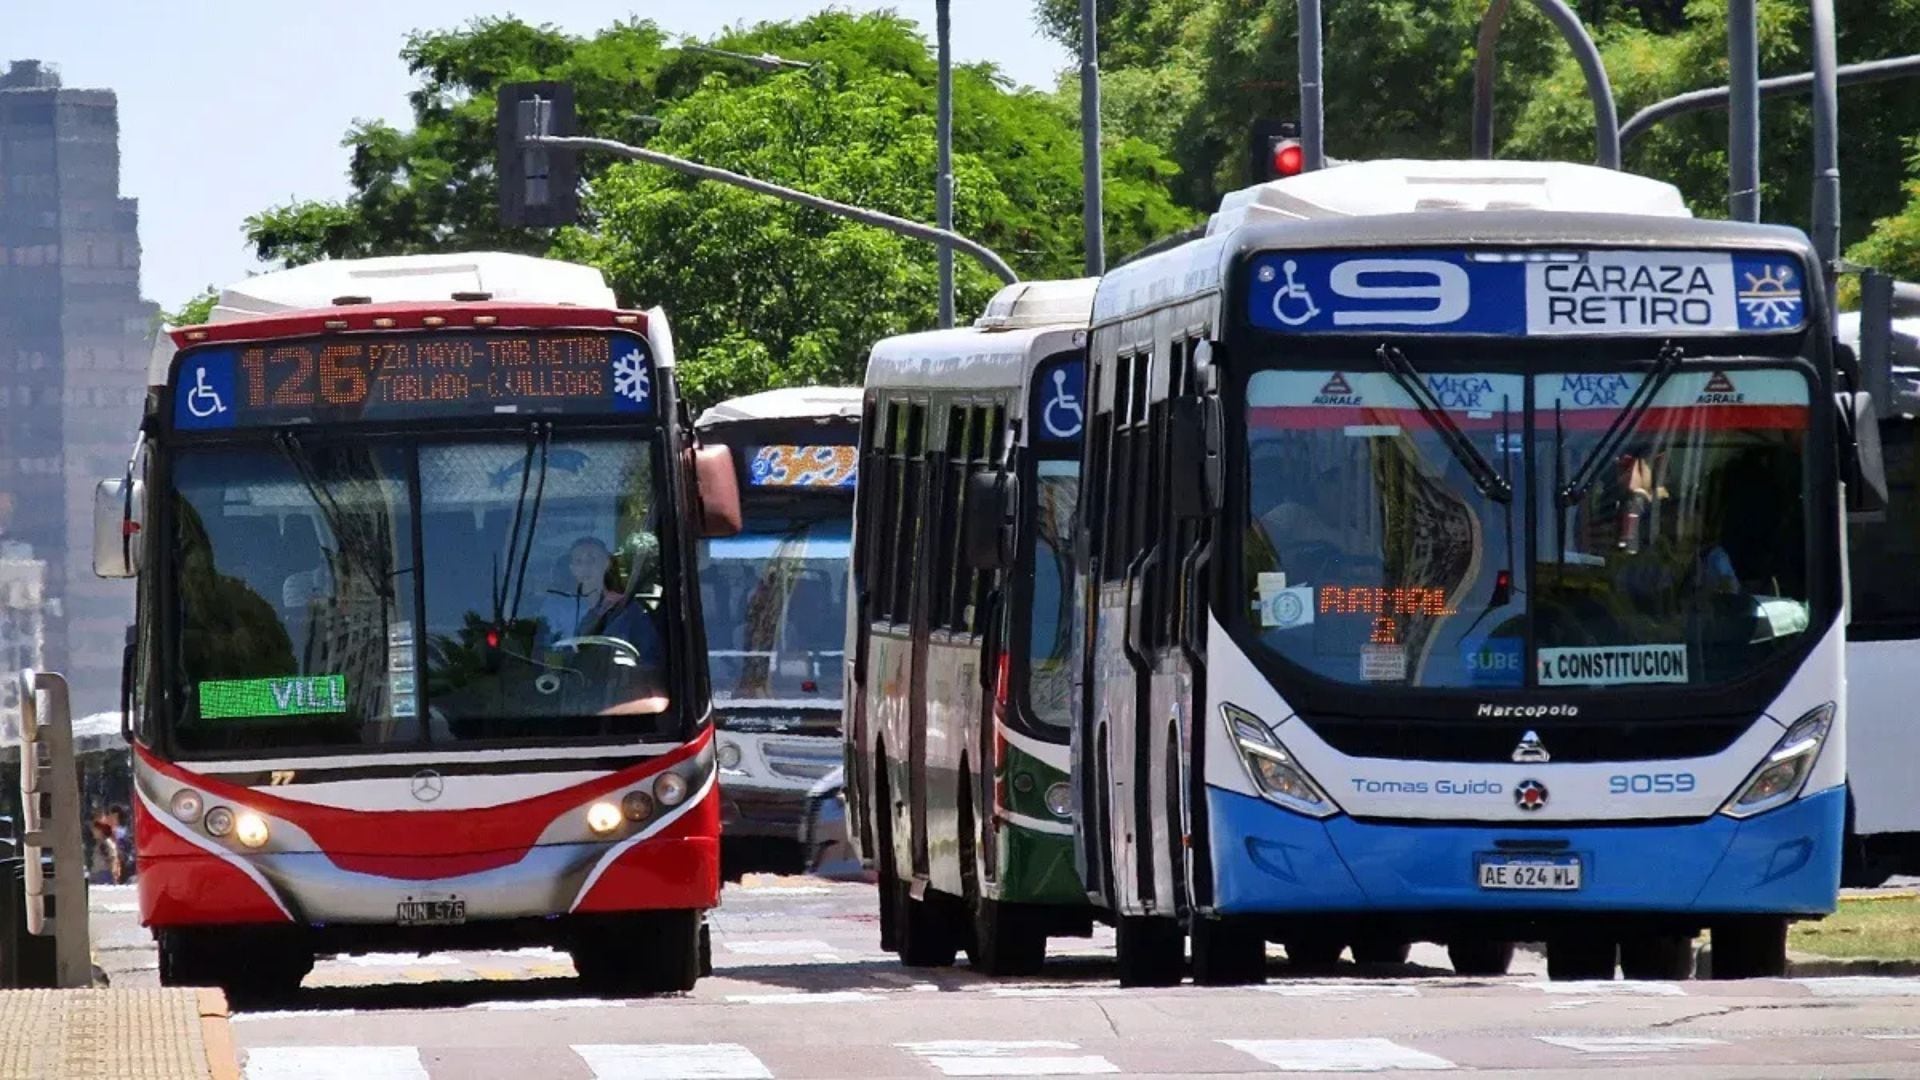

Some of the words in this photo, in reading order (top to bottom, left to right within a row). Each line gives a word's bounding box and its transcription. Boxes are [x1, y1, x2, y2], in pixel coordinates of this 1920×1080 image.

[1544, 264, 1714, 295] CARAZA
[1330, 259, 1470, 325] 9
[1548, 296, 1712, 325] RETIRO
[242, 345, 368, 406] 126
[1428, 375, 1494, 393] MEGA
[1561, 374, 1630, 392] MEGA
[1437, 390, 1484, 407] CAR
[1574, 389, 1619, 406] CAR
[1696, 393, 1745, 404] AGRALE
[1466, 652, 1520, 670] SUBE
[1557, 650, 1684, 679] CONSTITUCION
[1478, 704, 1579, 718] Marcopolo
[271, 771, 295, 786] 77
[1351, 778, 1429, 794] Tomas
[1435, 778, 1503, 794] Guido
[1609, 773, 1696, 794] 9059
[1485, 867, 1507, 885] AE
[1514, 867, 1548, 886] 624
[434, 901, 465, 920] 576
